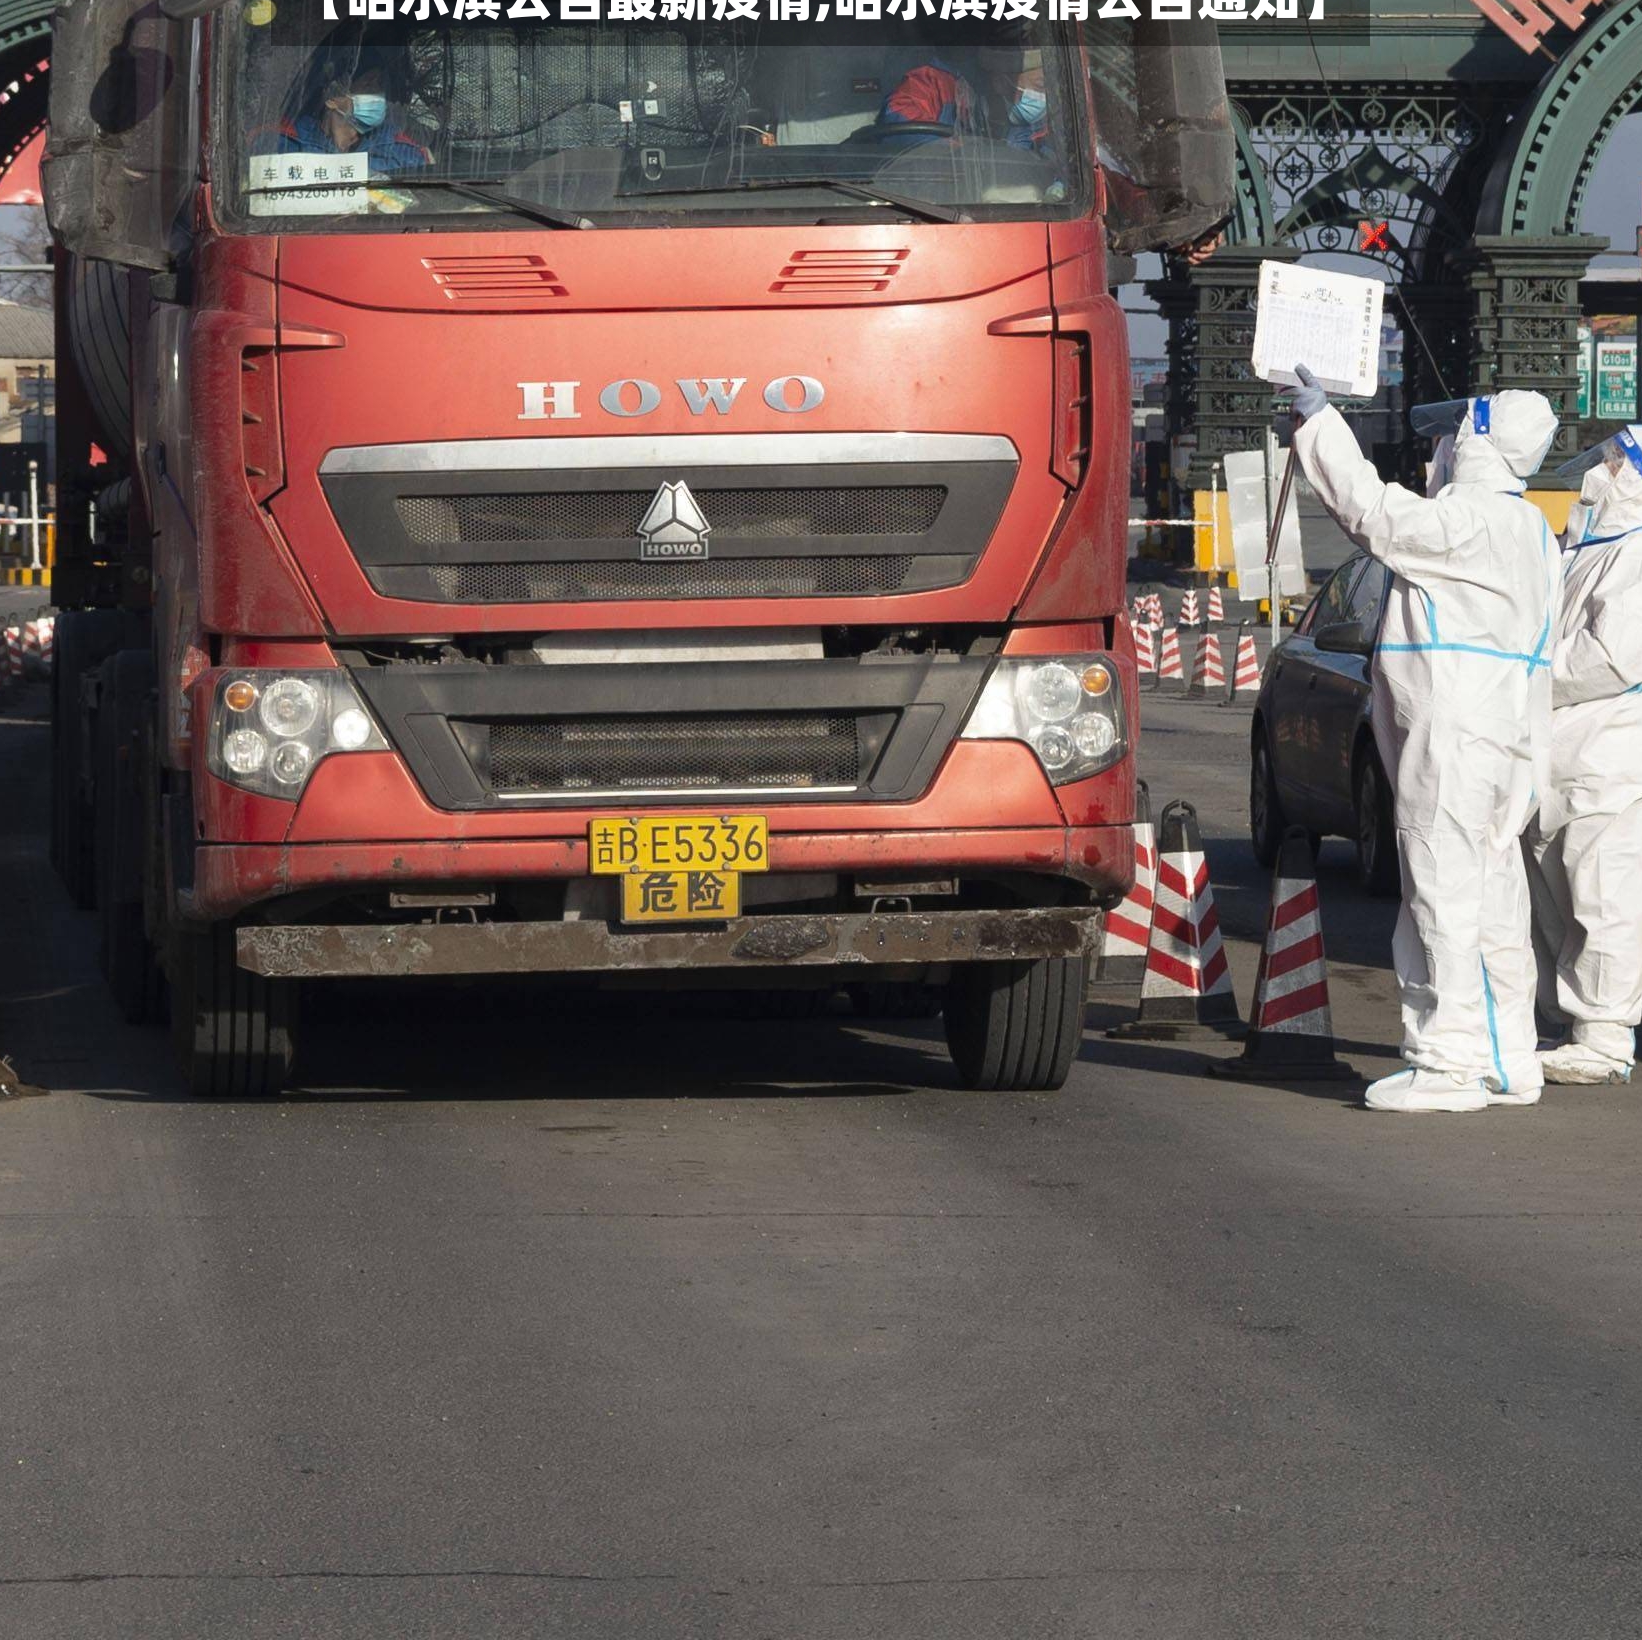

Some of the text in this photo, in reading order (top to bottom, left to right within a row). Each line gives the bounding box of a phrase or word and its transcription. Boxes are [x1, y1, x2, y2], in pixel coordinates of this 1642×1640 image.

[263, 165, 355, 182] 车载电话
[516, 374, 826, 420] HOWO
[646, 542, 703, 557] HOWO
[639, 871, 726, 913] 危险
